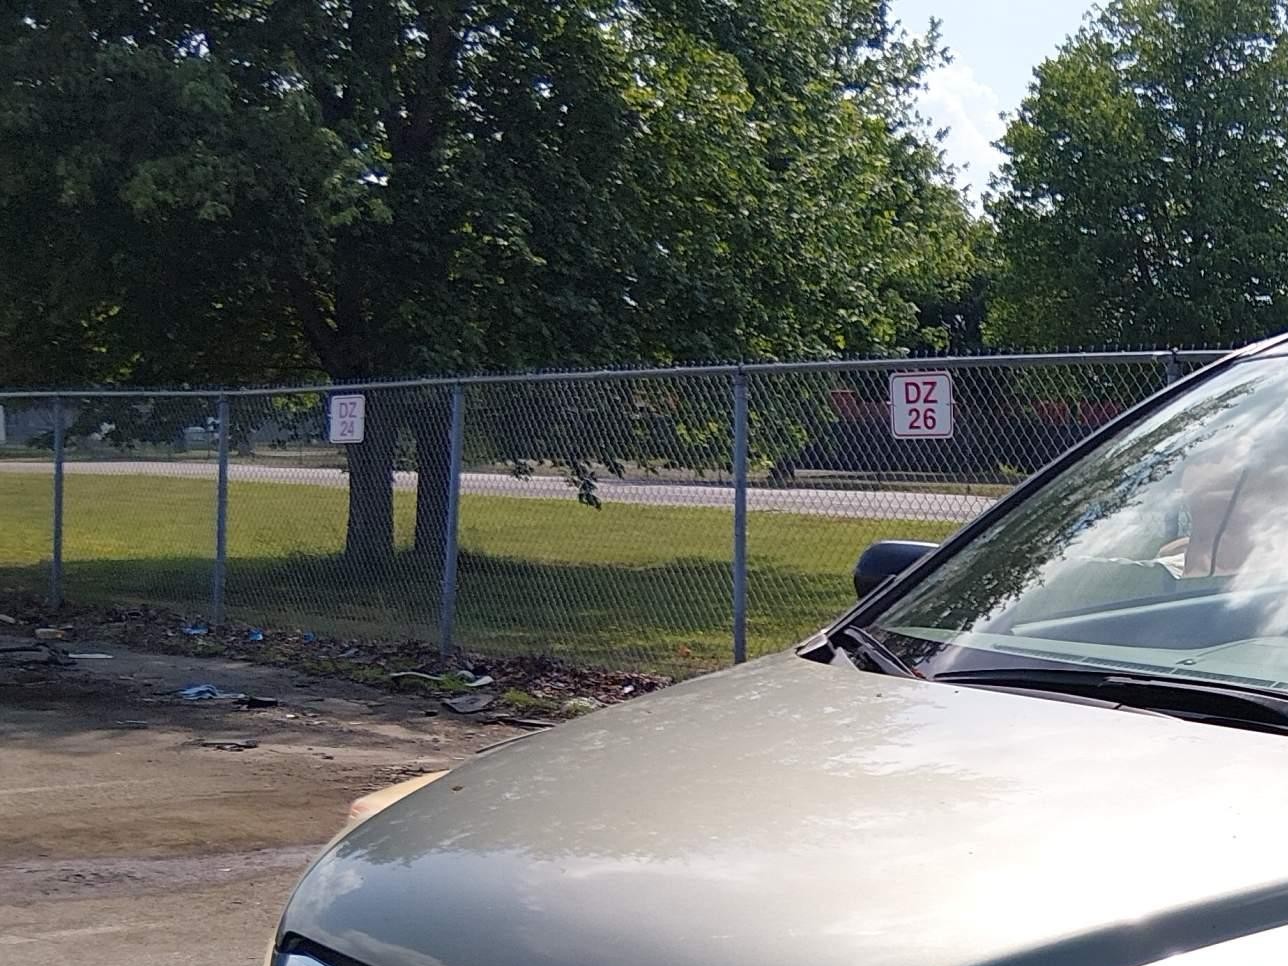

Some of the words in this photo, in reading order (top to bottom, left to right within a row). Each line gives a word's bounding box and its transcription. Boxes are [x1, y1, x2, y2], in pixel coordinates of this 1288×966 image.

[904, 381, 938, 404] DZ
[338, 401, 358, 419] DZ
[908, 407, 937, 430] 26
[339, 420, 355, 437] 24
